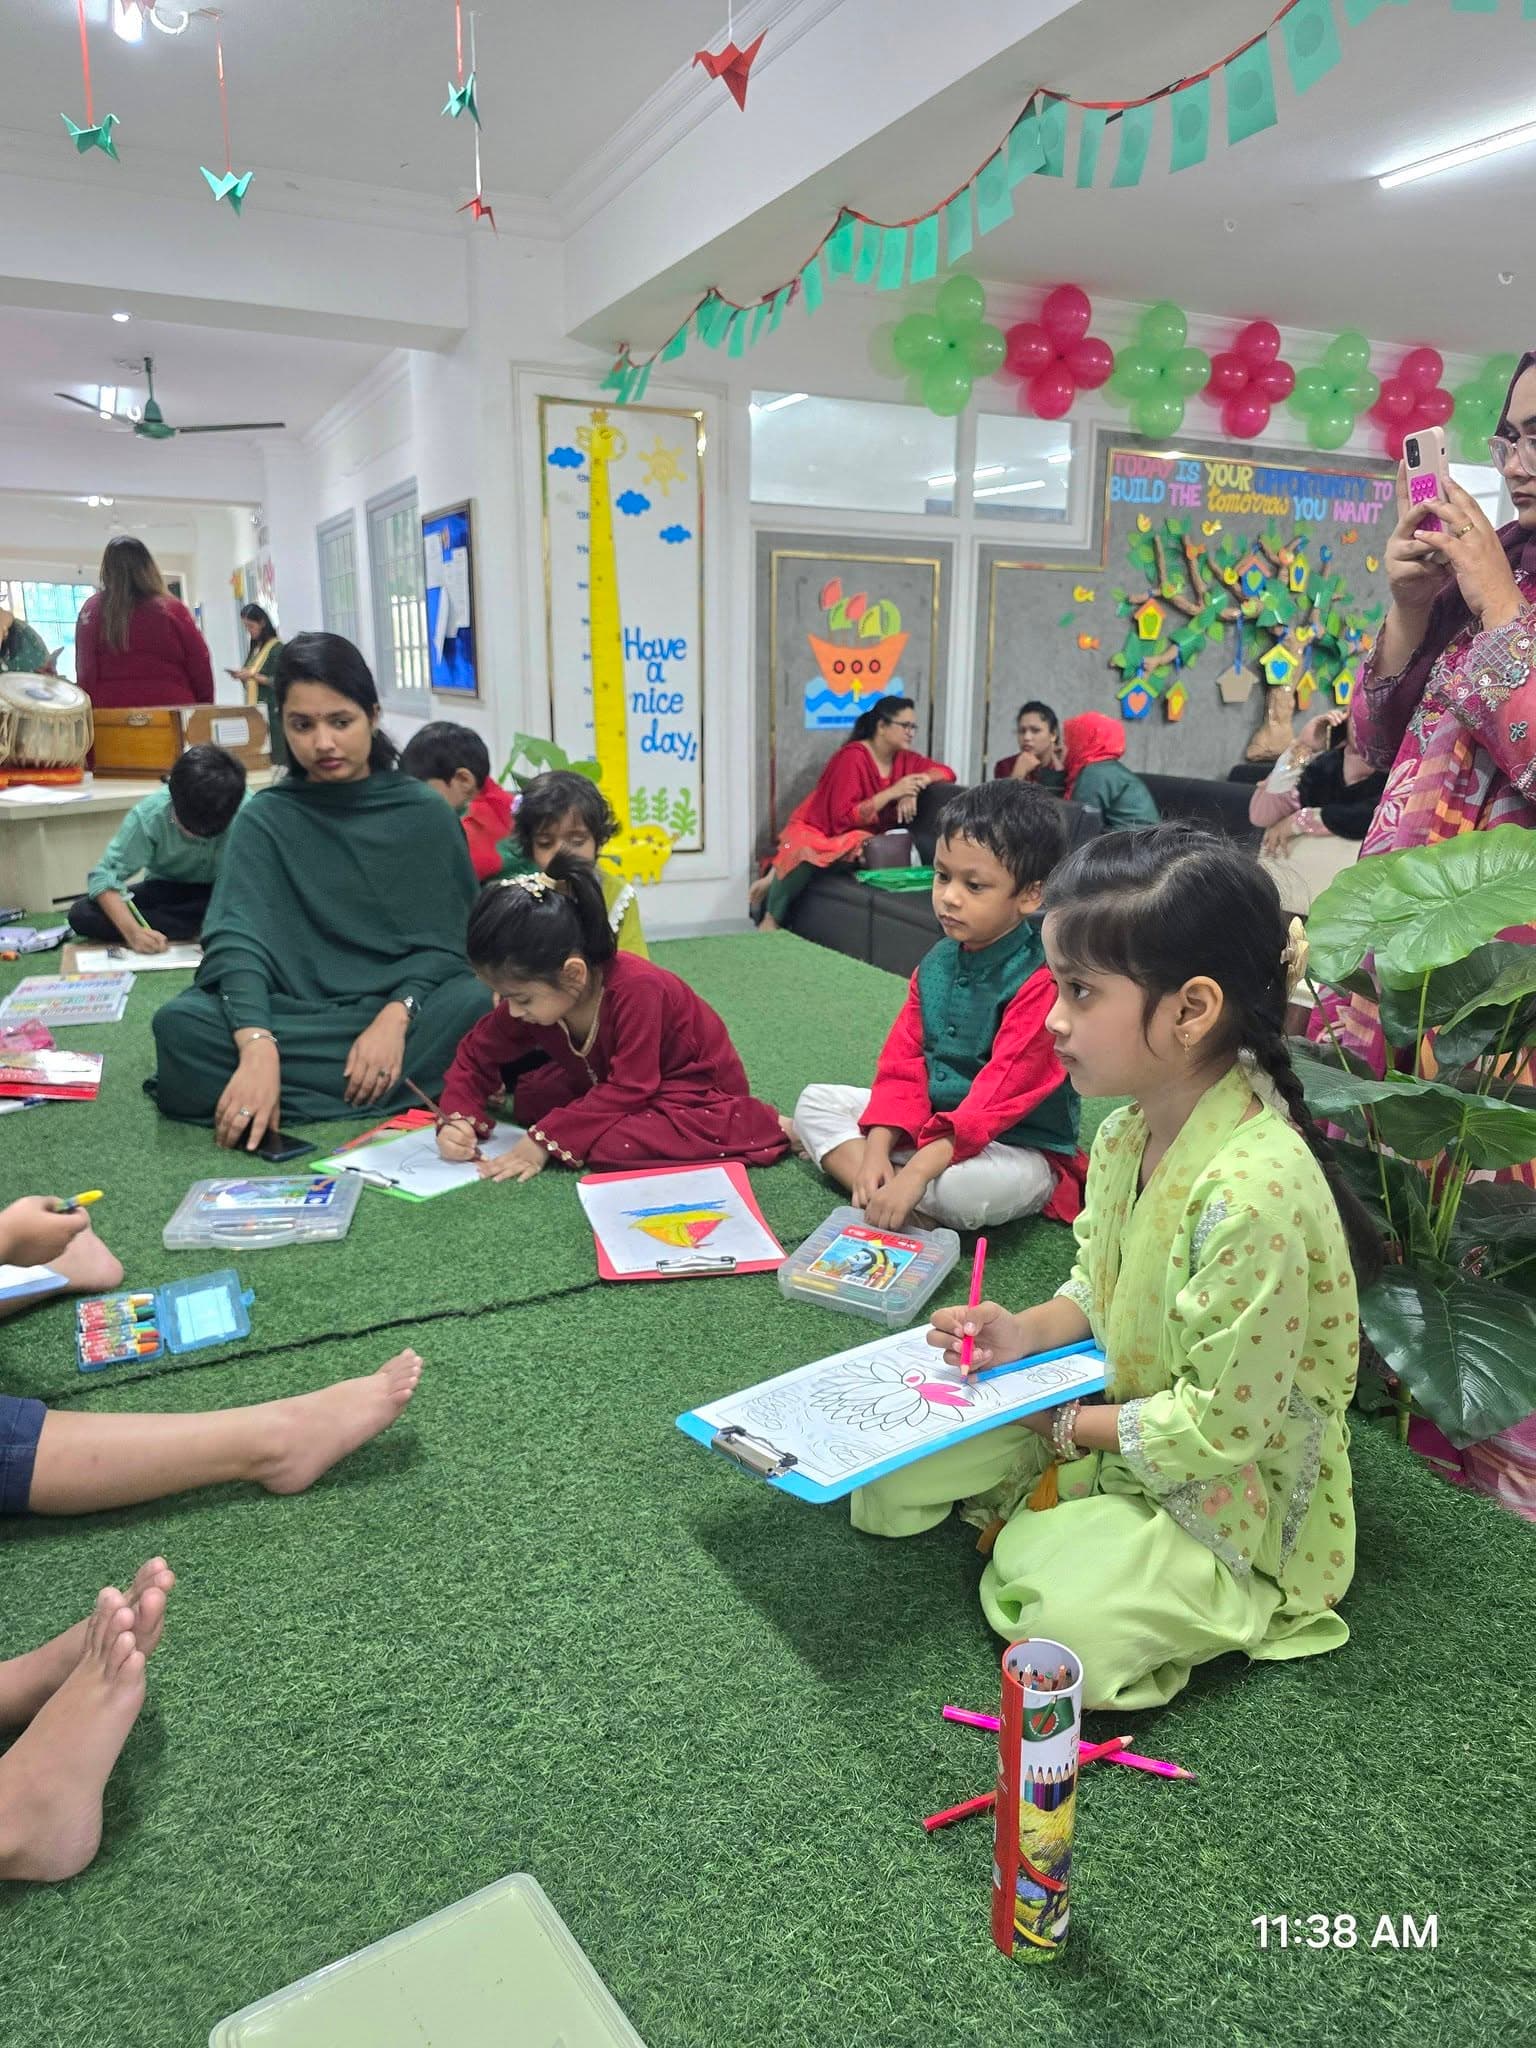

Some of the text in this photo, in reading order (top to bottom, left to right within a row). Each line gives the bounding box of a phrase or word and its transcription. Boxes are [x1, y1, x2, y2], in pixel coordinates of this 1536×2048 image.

[1114, 454, 1176, 479] TODAY
[1175, 460, 1201, 482] IS
[1204, 462, 1254, 492] YOUR
[1372, 481, 1393, 501] TO
[1110, 476, 1384, 524] BUILD THE tomorrow YOU WANT
[624, 627, 687, 661] Have
[647, 659, 667, 684] a
[632, 688, 684, 714] nice
[641, 719, 698, 762] day!
